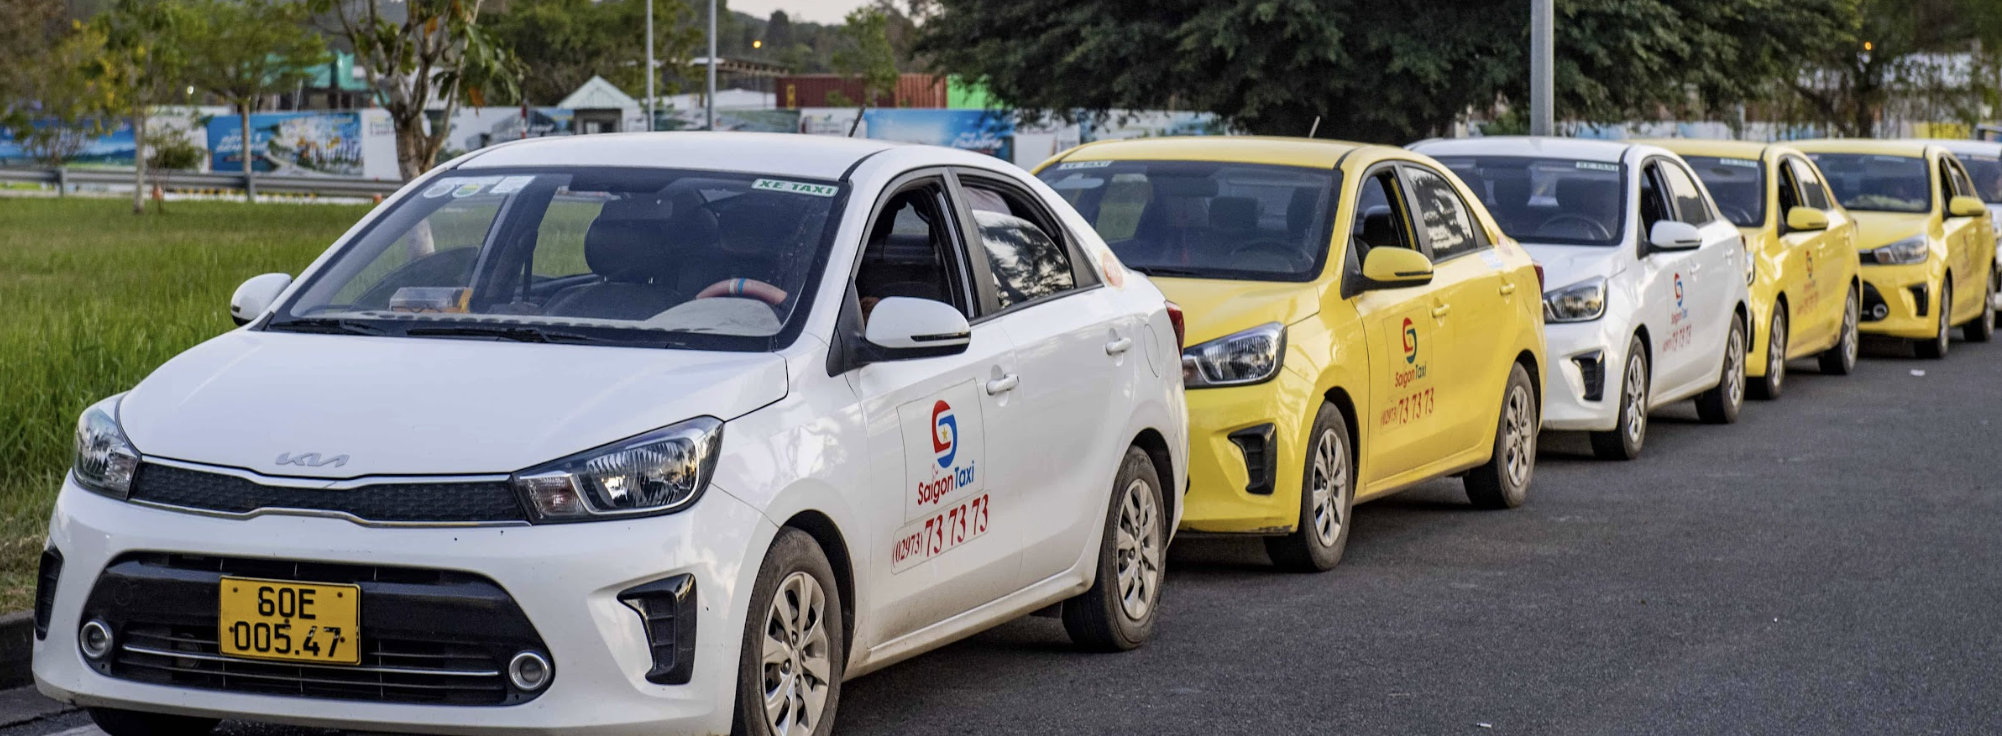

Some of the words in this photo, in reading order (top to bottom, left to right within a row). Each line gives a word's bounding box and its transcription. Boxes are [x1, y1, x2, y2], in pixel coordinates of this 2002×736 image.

[760, 181, 784, 190] XE
[791, 183, 834, 195] TAXI
[1395, 369, 1415, 389] Saigon
[1415, 360, 1427, 380] Taxi
[1399, 396, 1409, 425] 73
[1411, 391, 1422, 420] 73
[1424, 386, 1434, 415] 73
[275, 452, 350, 468] KIA
[917, 474, 954, 506] Saigon
[954, 459, 975, 490] Taxi
[892, 531, 923, 568] (02973)
[924, 513, 944, 558] 73
[948, 503, 967, 547] 73
[971, 493, 989, 536] 73
[258, 586, 316, 620] 60E
[234, 621, 341, 658] 005.47
